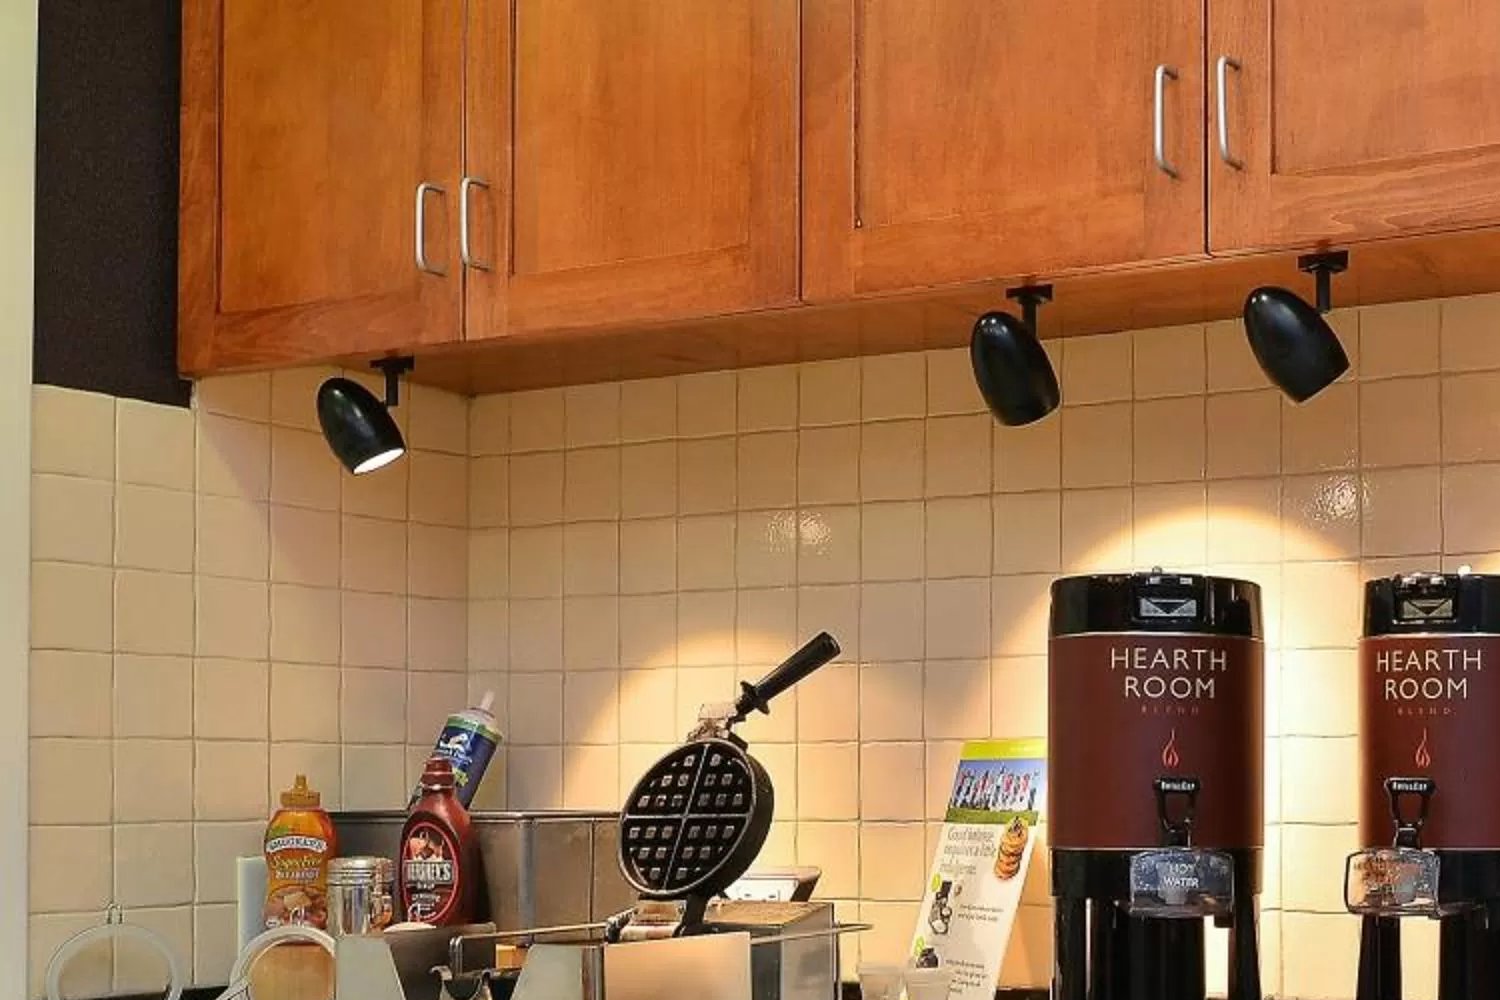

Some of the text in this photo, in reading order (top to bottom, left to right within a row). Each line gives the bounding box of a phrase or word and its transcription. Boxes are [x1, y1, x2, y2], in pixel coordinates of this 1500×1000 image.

[1111, 647, 1227, 671] HEARTH
[1376, 649, 1482, 672] HEARTH
[1125, 676, 1215, 698] ROOM
[1385, 677, 1468, 700] ROOM
[1163, 876, 1199, 888] WATER
